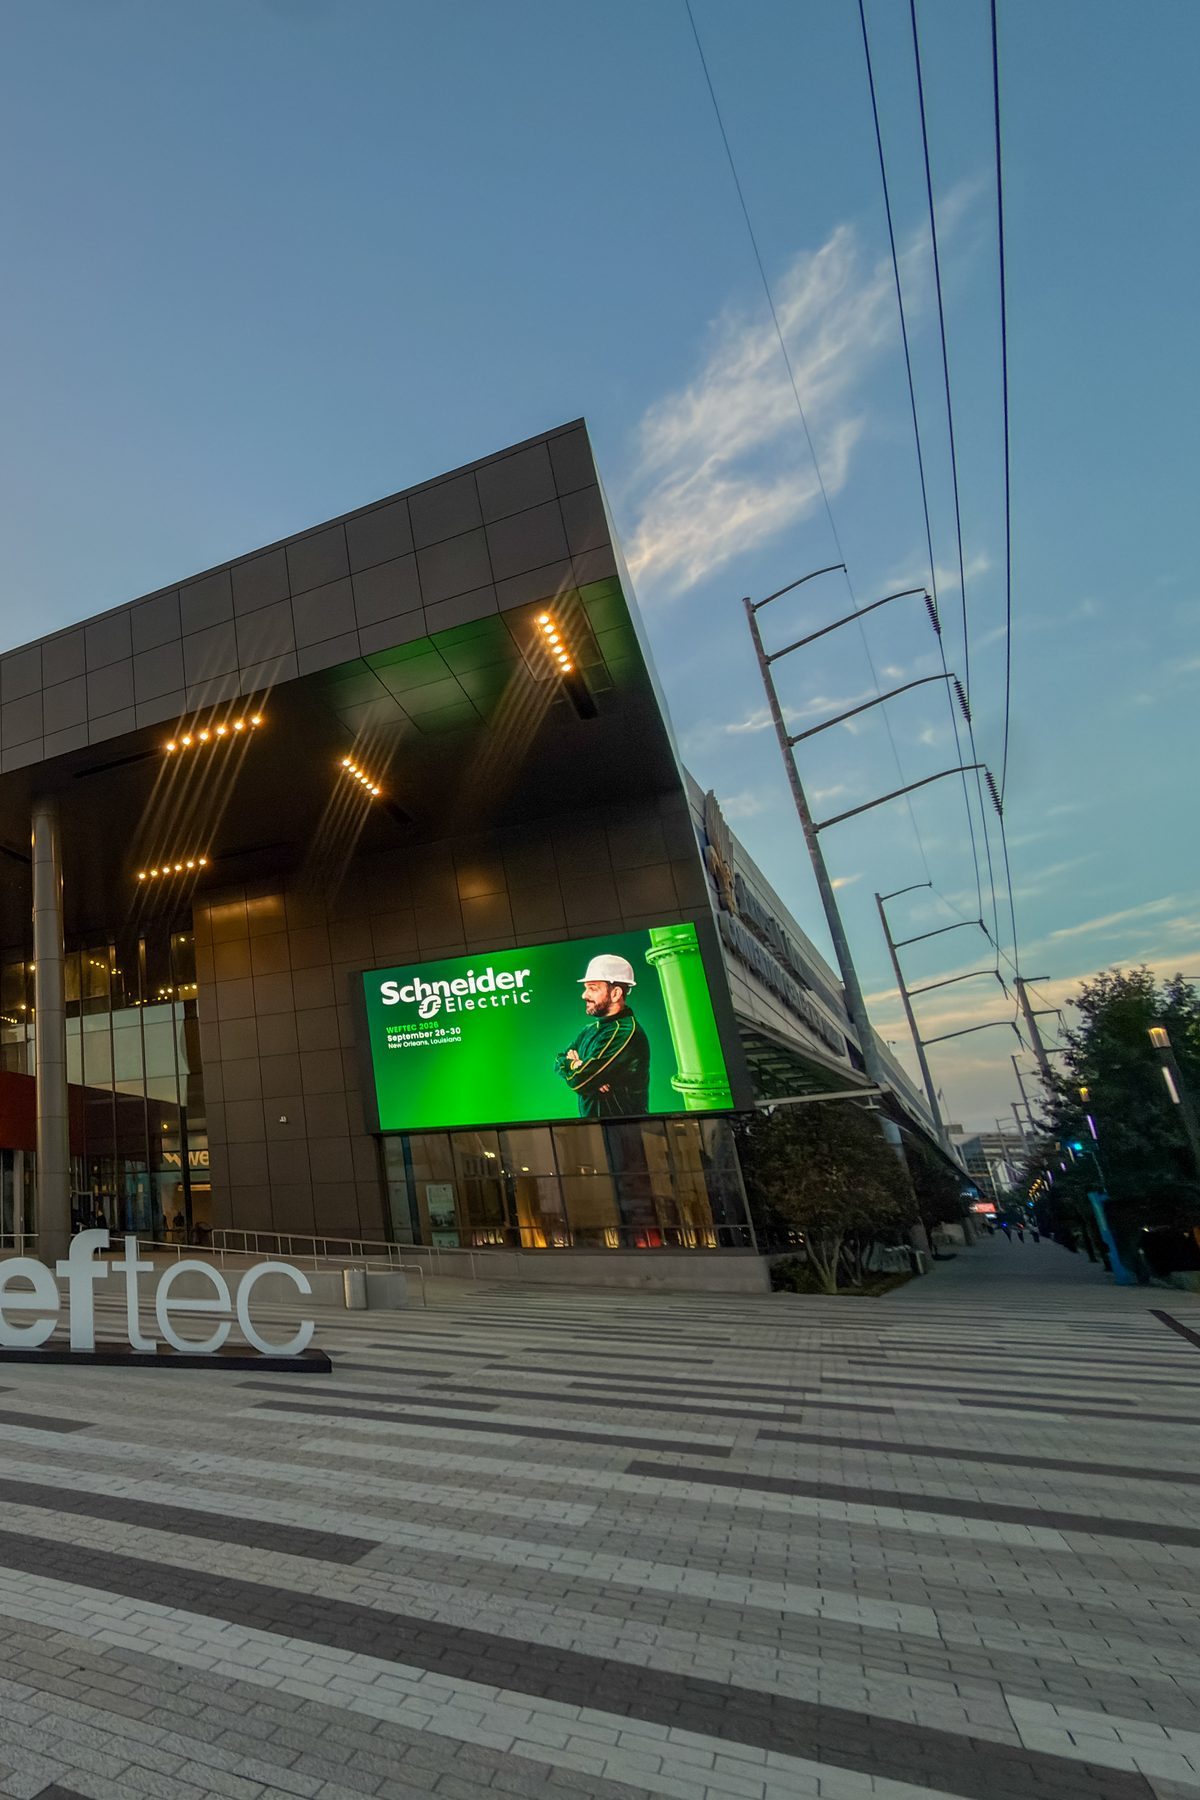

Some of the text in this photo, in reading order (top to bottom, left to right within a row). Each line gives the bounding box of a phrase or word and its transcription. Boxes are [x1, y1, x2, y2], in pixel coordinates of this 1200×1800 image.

[380, 967, 531, 1005] Schneider
[445, 990, 531, 1013] Electric
[386, 1024, 417, 1034] WEFTEC
[387, 1031, 433, 1043] September
[430, 1036, 462, 1045] Louisiana
